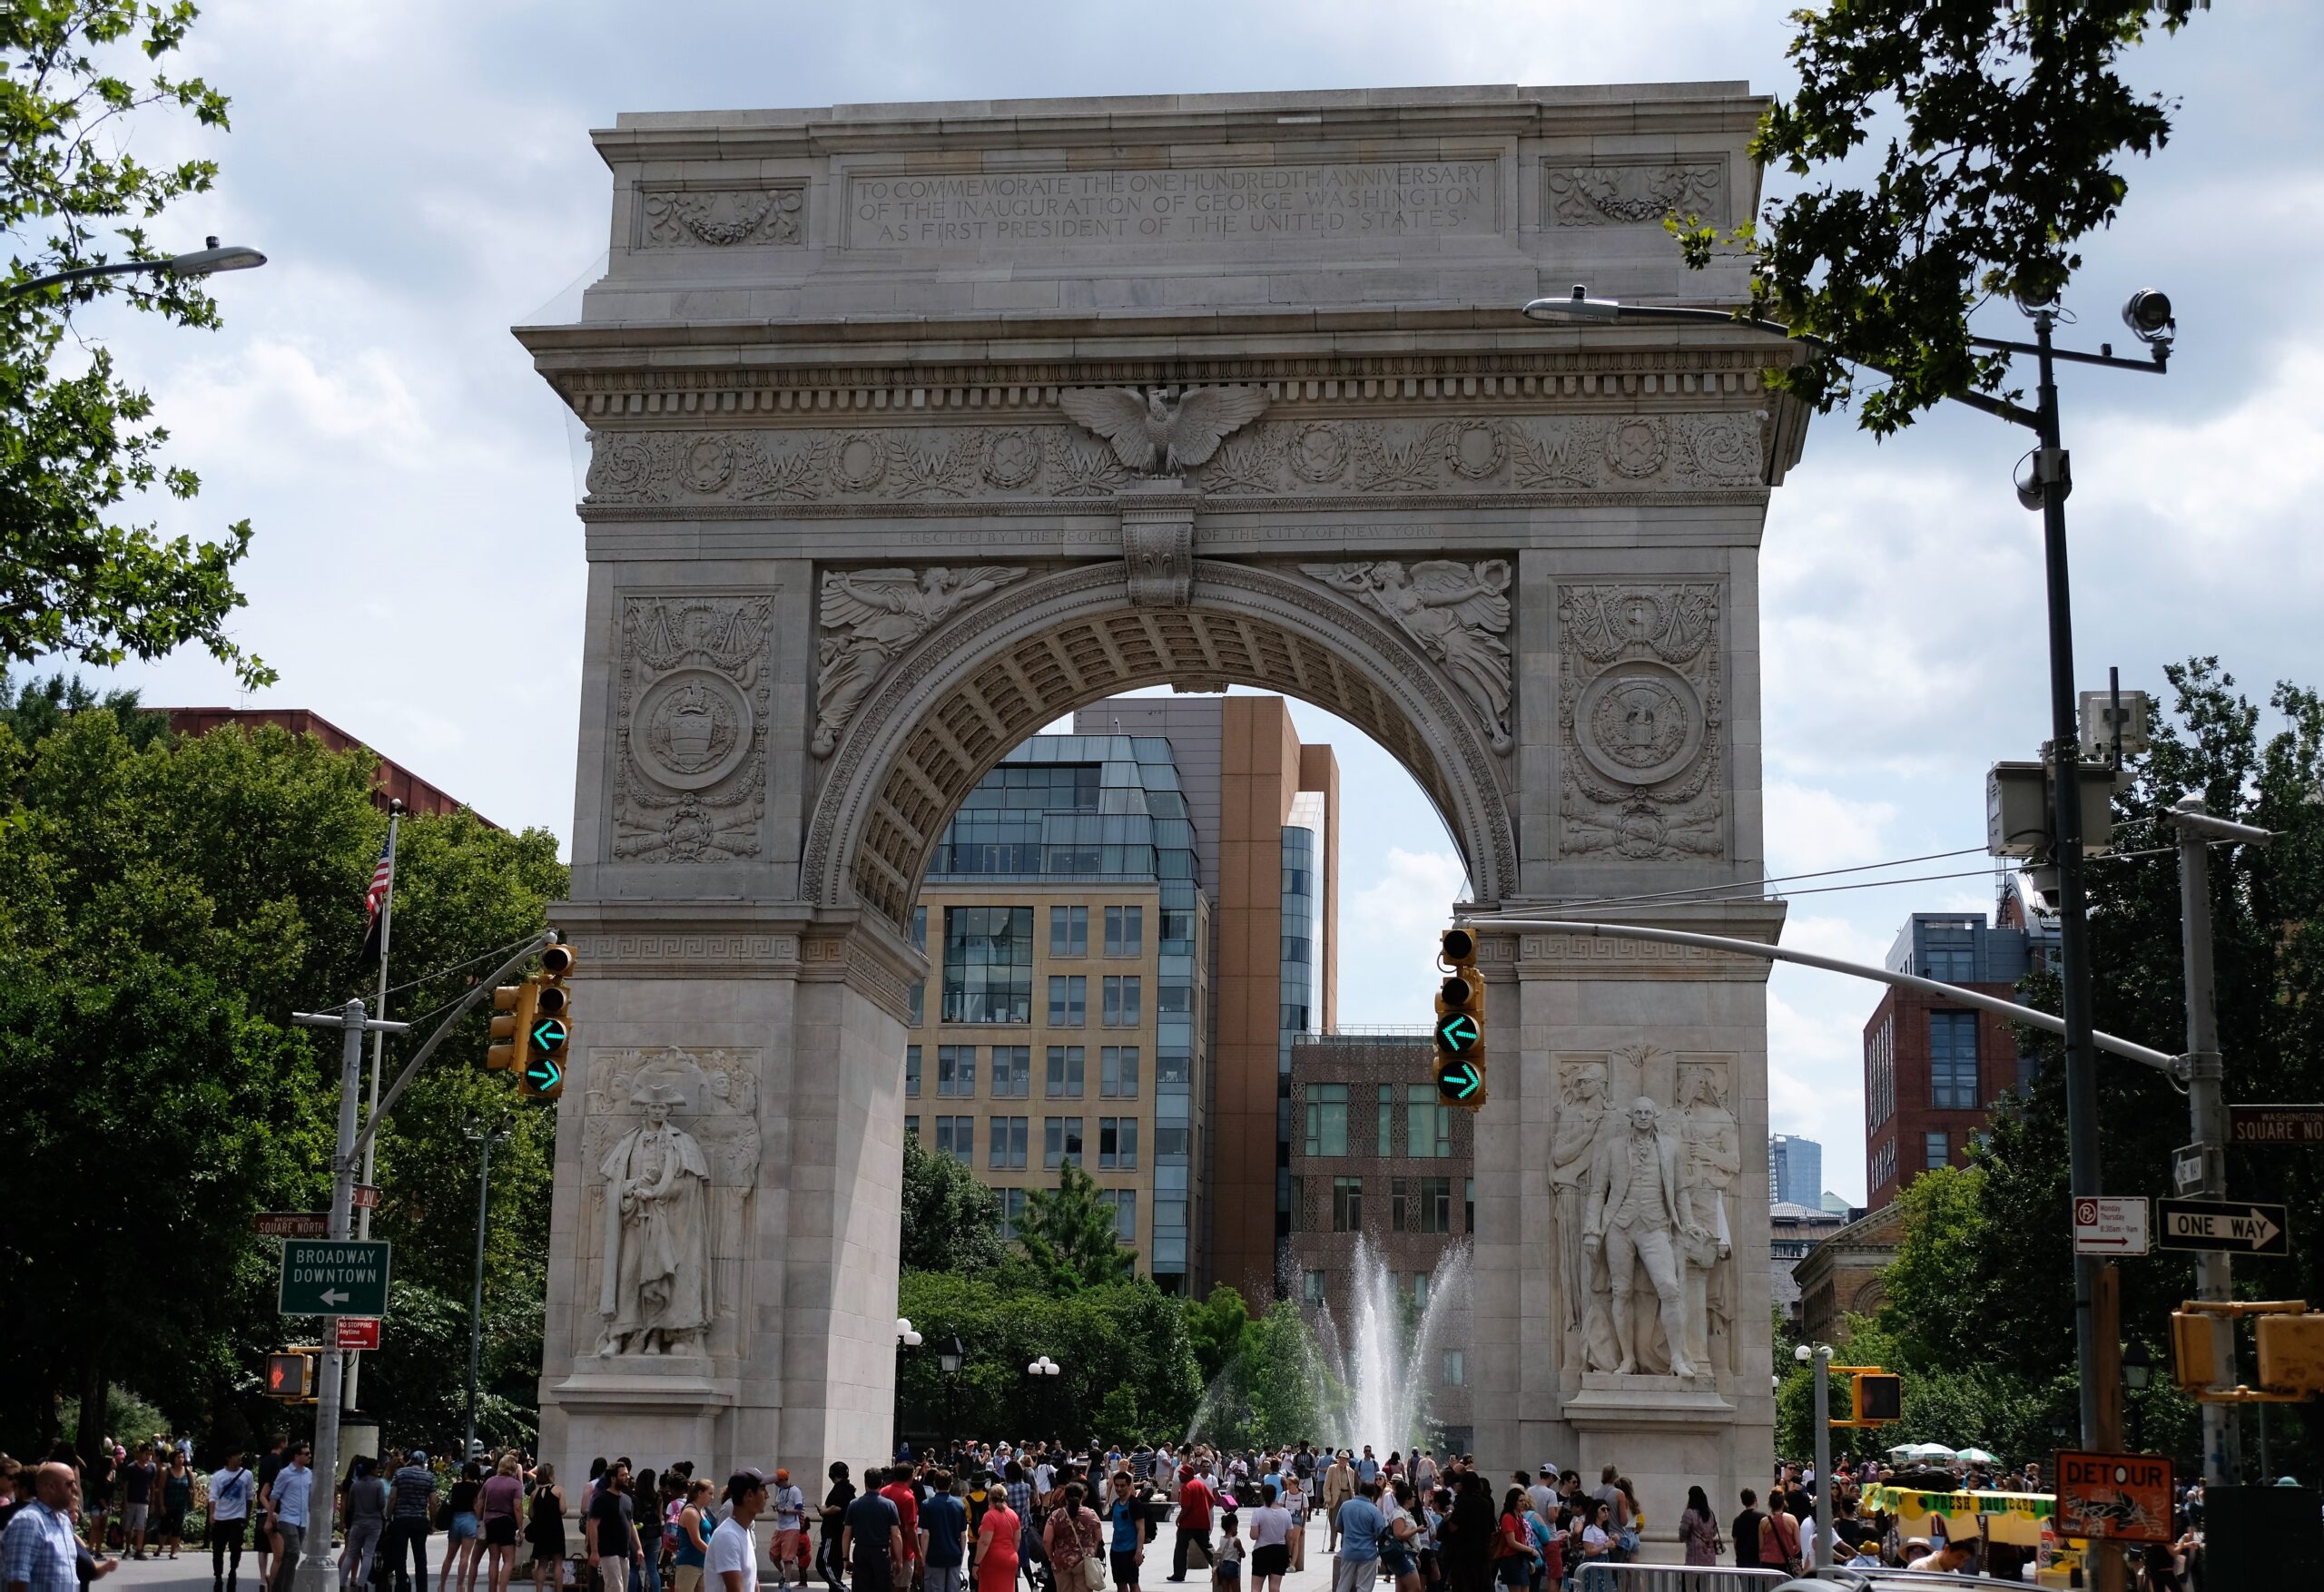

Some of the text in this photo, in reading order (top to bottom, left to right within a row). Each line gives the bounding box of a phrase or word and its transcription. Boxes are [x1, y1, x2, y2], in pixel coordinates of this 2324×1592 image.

[857, 164, 1485, 200] TO COMMEMORATE THE ONE HUNDREDTH ANNIVERSARY
[858, 187, 1481, 221] OF THE INAUGURATION OF GEORGE WASHINGTON
[878, 223, 909, 241] AS
[921, 221, 989, 241] FIRST
[998, 218, 1128, 239] PRESIDENT
[1140, 217, 1174, 235] OF
[1186, 215, 1237, 234] THE
[1250, 211, 1344, 232] UNITED
[919, 449, 950, 474] W
[1072, 447, 1104, 473] W
[1225, 443, 1256, 470] W
[1382, 440, 1413, 467] W
[1540, 437, 1569, 467] W
[767, 453, 800, 477] W
[900, 529, 1119, 545] ERECTED BY THE PEOPLE
[1201, 524, 1437, 542] OF THE CITY OF NEW YORK
[2260, 1112, 2324, 1123] WASHINGTON
[2237, 1122, 2294, 1141] SQUARE
[362, 1189, 375, 1206] AV
[2100, 1204, 2121, 1214] Monday
[2100, 1214, 2124, 1222] Thursday
[259, 1222, 324, 1233] SQUARE NORTH
[2126, 1225, 2138, 1233] 9am
[2177, 1216, 2268, 1239] ONE WAY
[295, 1250, 376, 1264] BROADWAY
[293, 1269, 377, 1283] DOWNTOWN
[2066, 1460, 2163, 1489] DETOUR
[1933, 1495, 1971, 1510] FRESH
[1979, 1498, 2036, 1513] SQUEEZED
